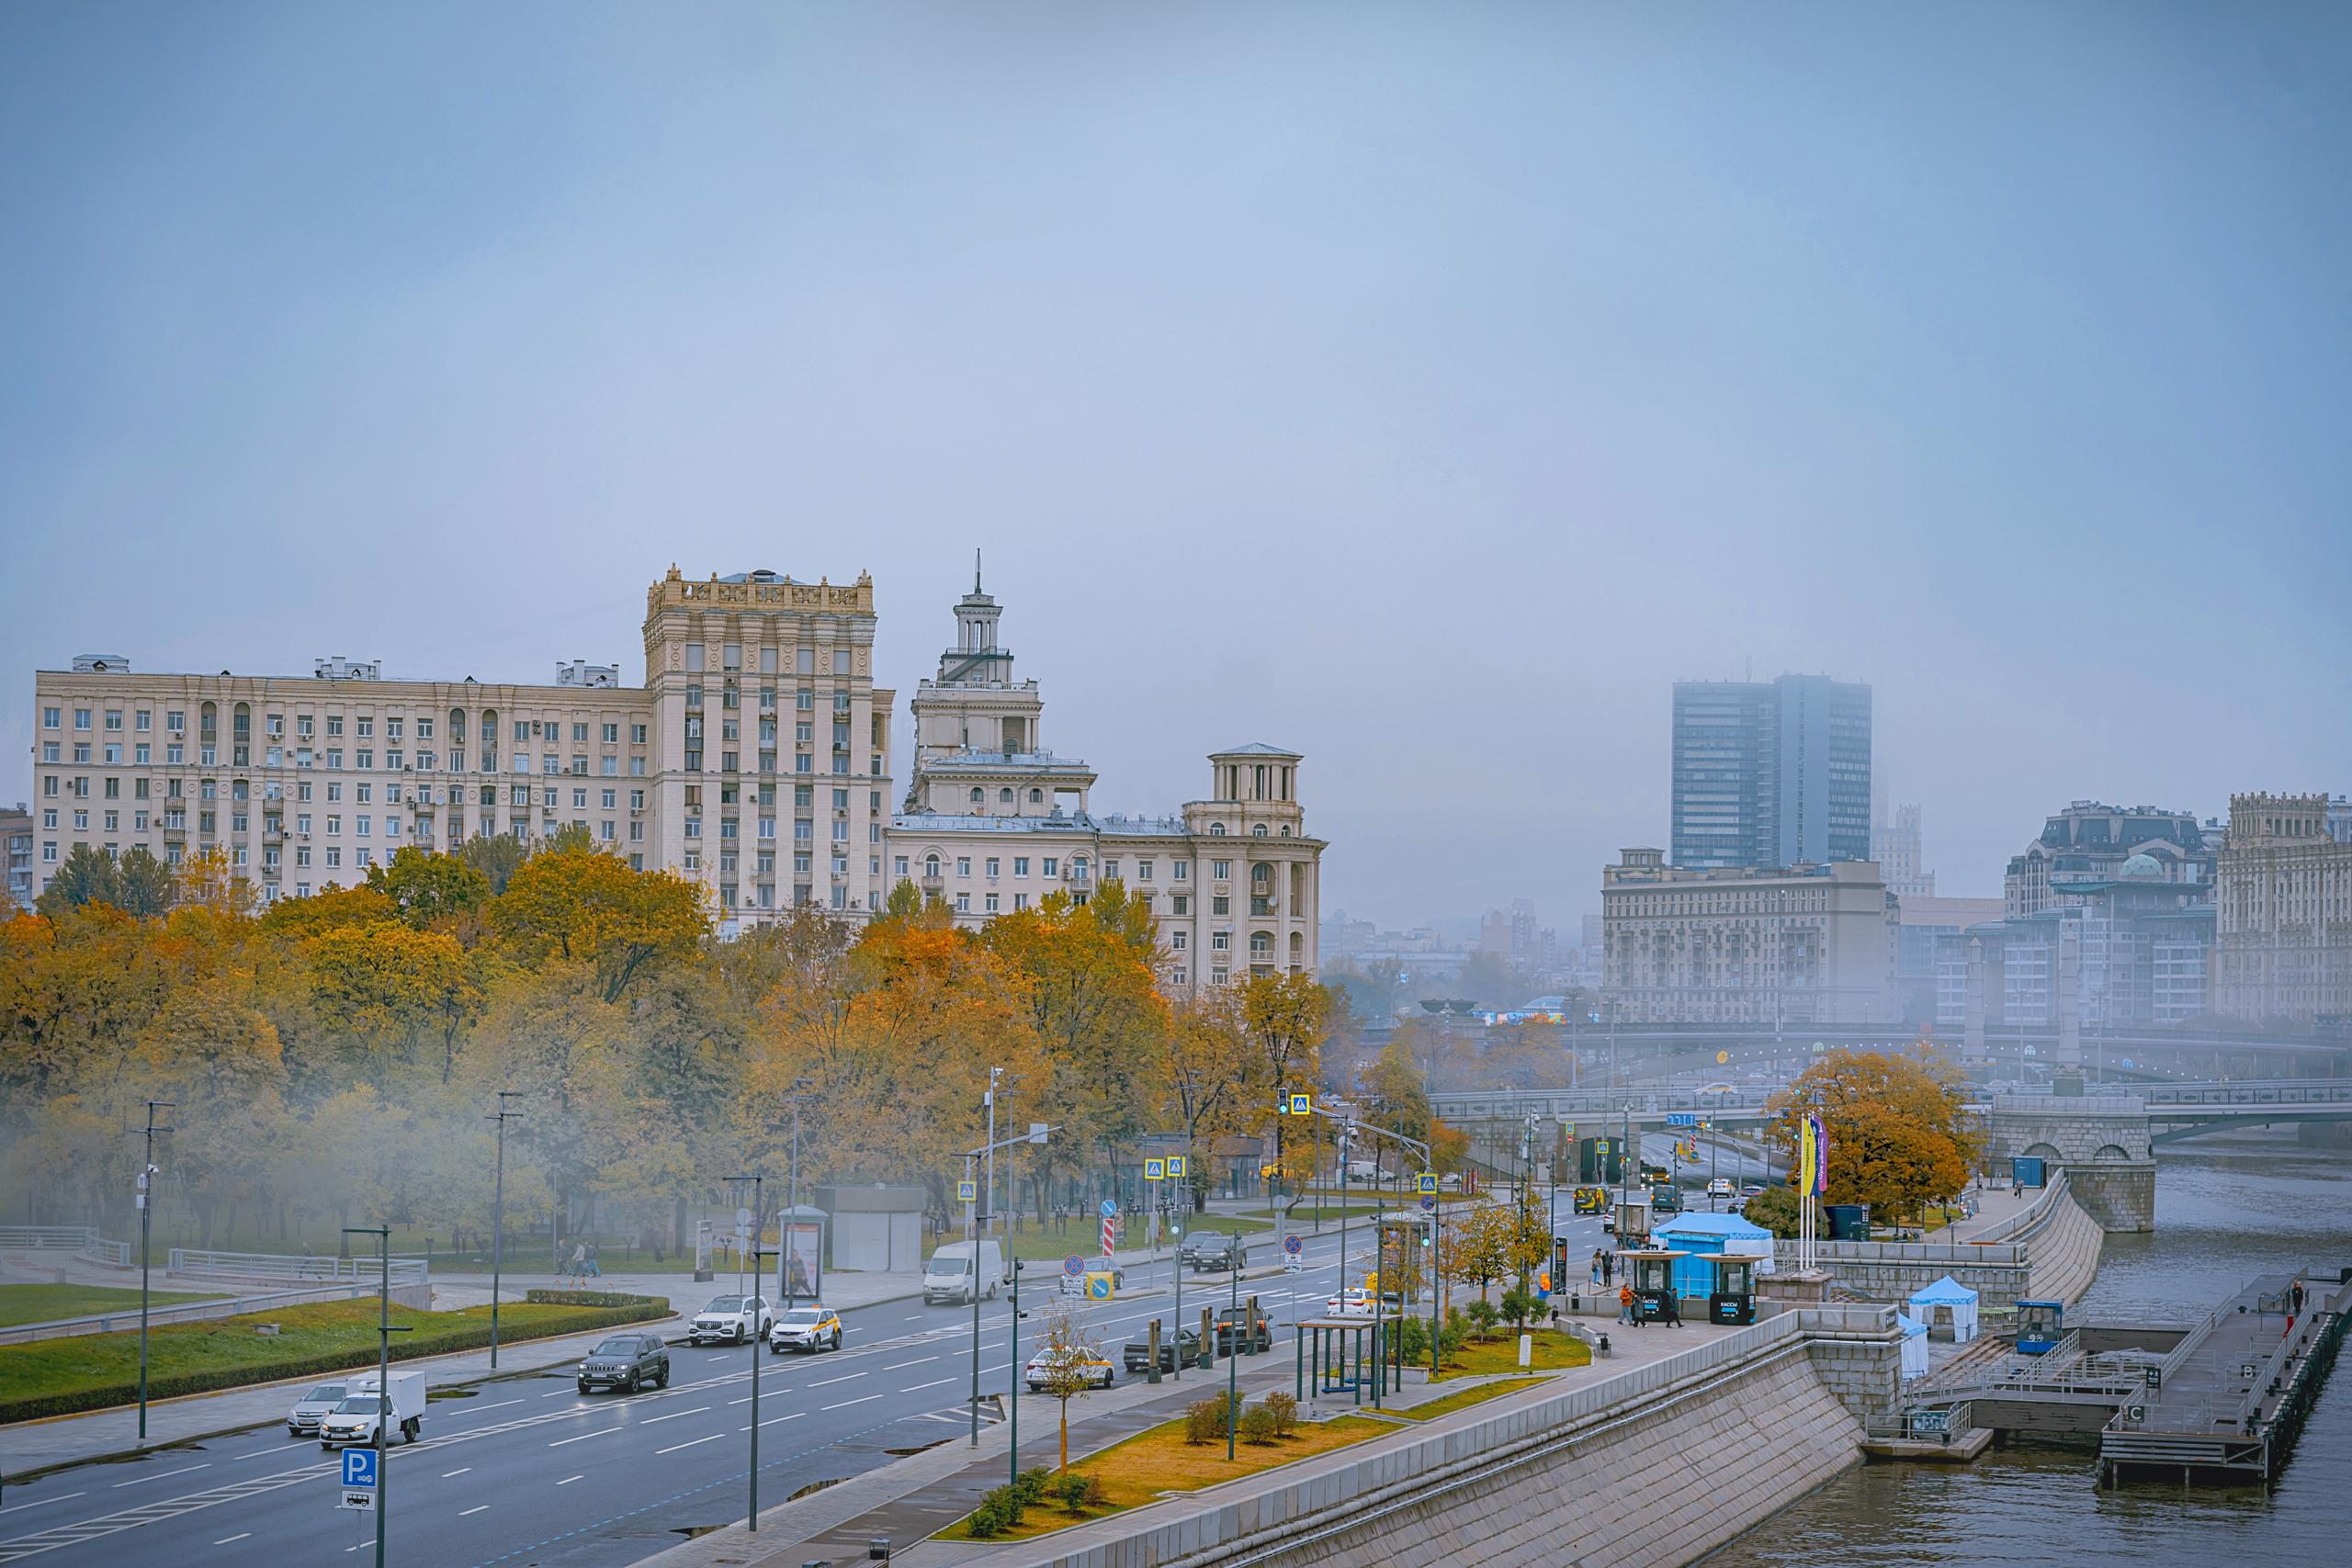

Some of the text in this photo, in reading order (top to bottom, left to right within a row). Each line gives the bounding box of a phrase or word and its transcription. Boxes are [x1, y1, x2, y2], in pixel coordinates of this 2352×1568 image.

[2244, 1366, 2253, 1378] B
[2130, 1406, 2142, 1420] C
[348, 1453, 368, 1482] P
